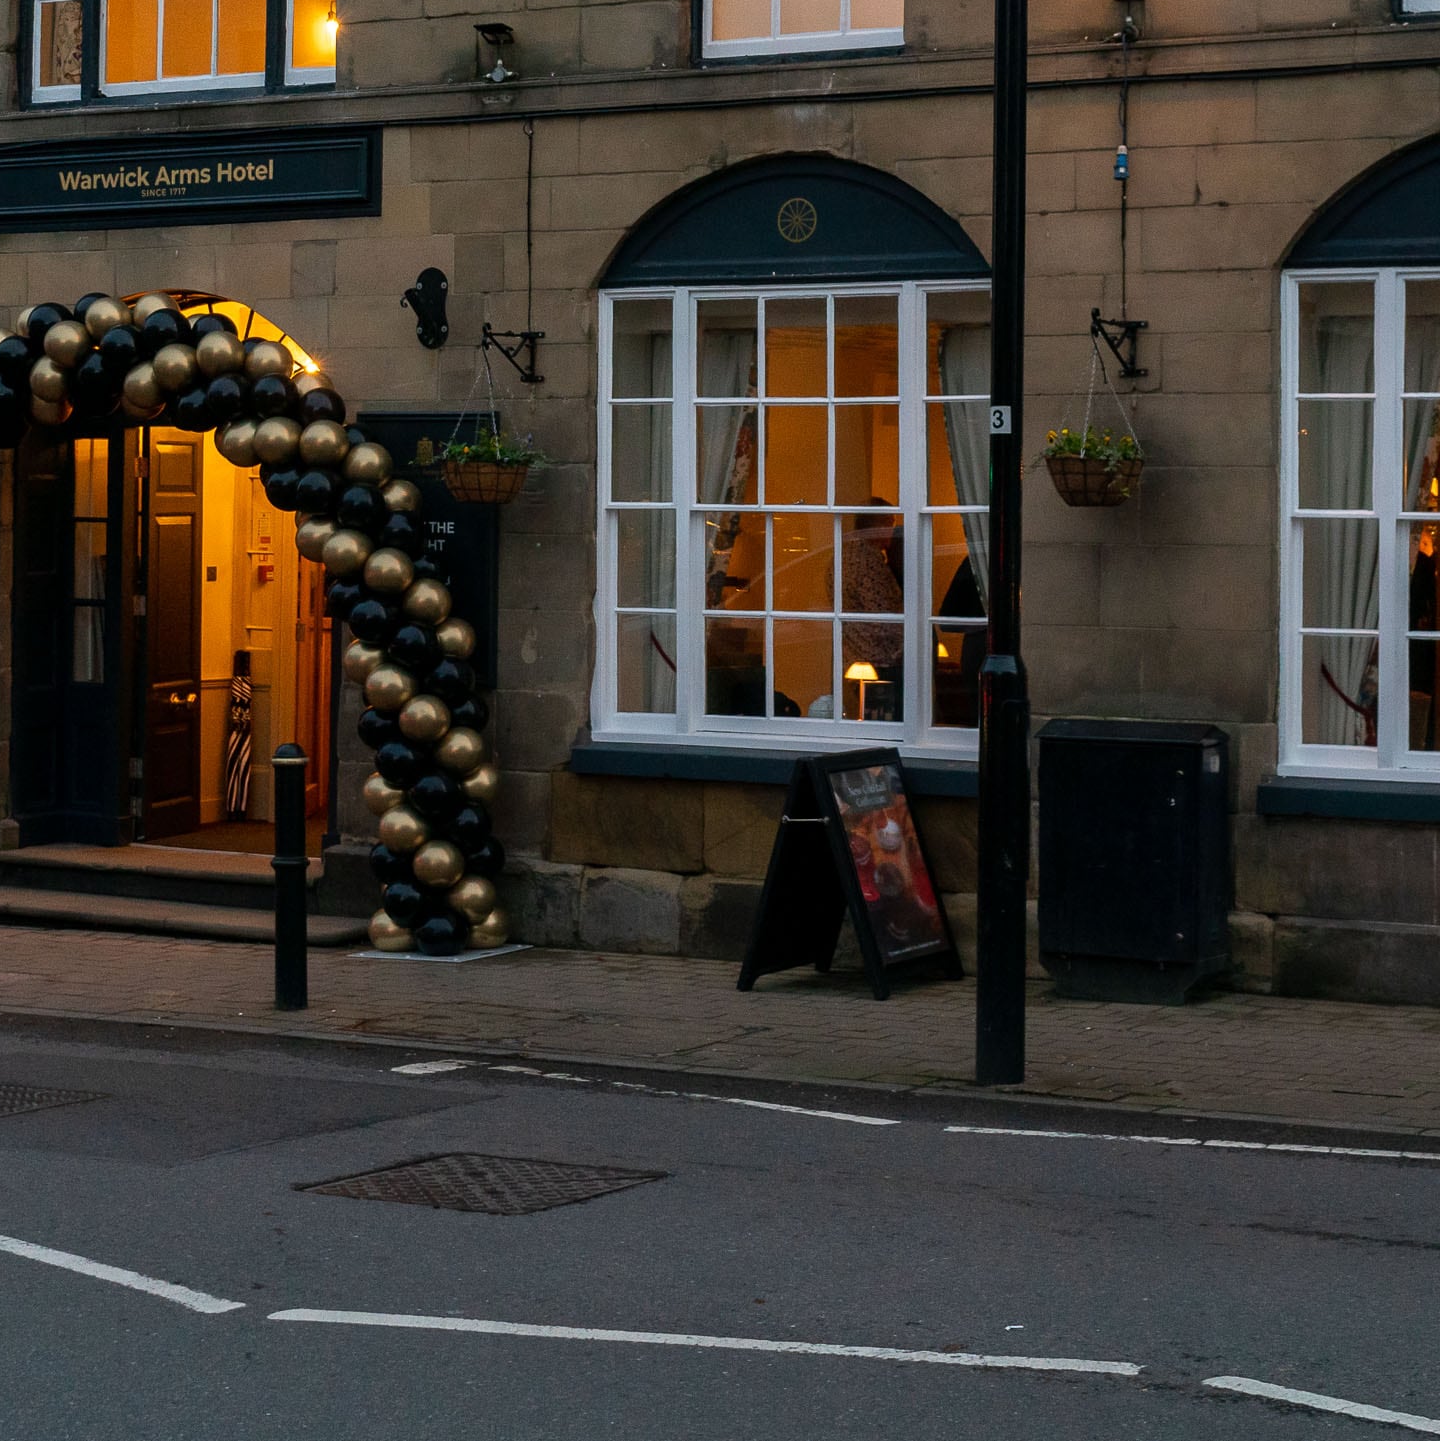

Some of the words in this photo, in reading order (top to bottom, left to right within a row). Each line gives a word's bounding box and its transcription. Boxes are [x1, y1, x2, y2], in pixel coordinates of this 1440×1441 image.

[59, 166, 150, 191] Warwick
[154, 166, 210, 186] Arms
[217, 159, 274, 183] Hotel
[141, 187, 167, 198] SINCE
[169, 187, 187, 197] 1717
[992, 409, 1005, 429] 3
[429, 521, 455, 534] THE
